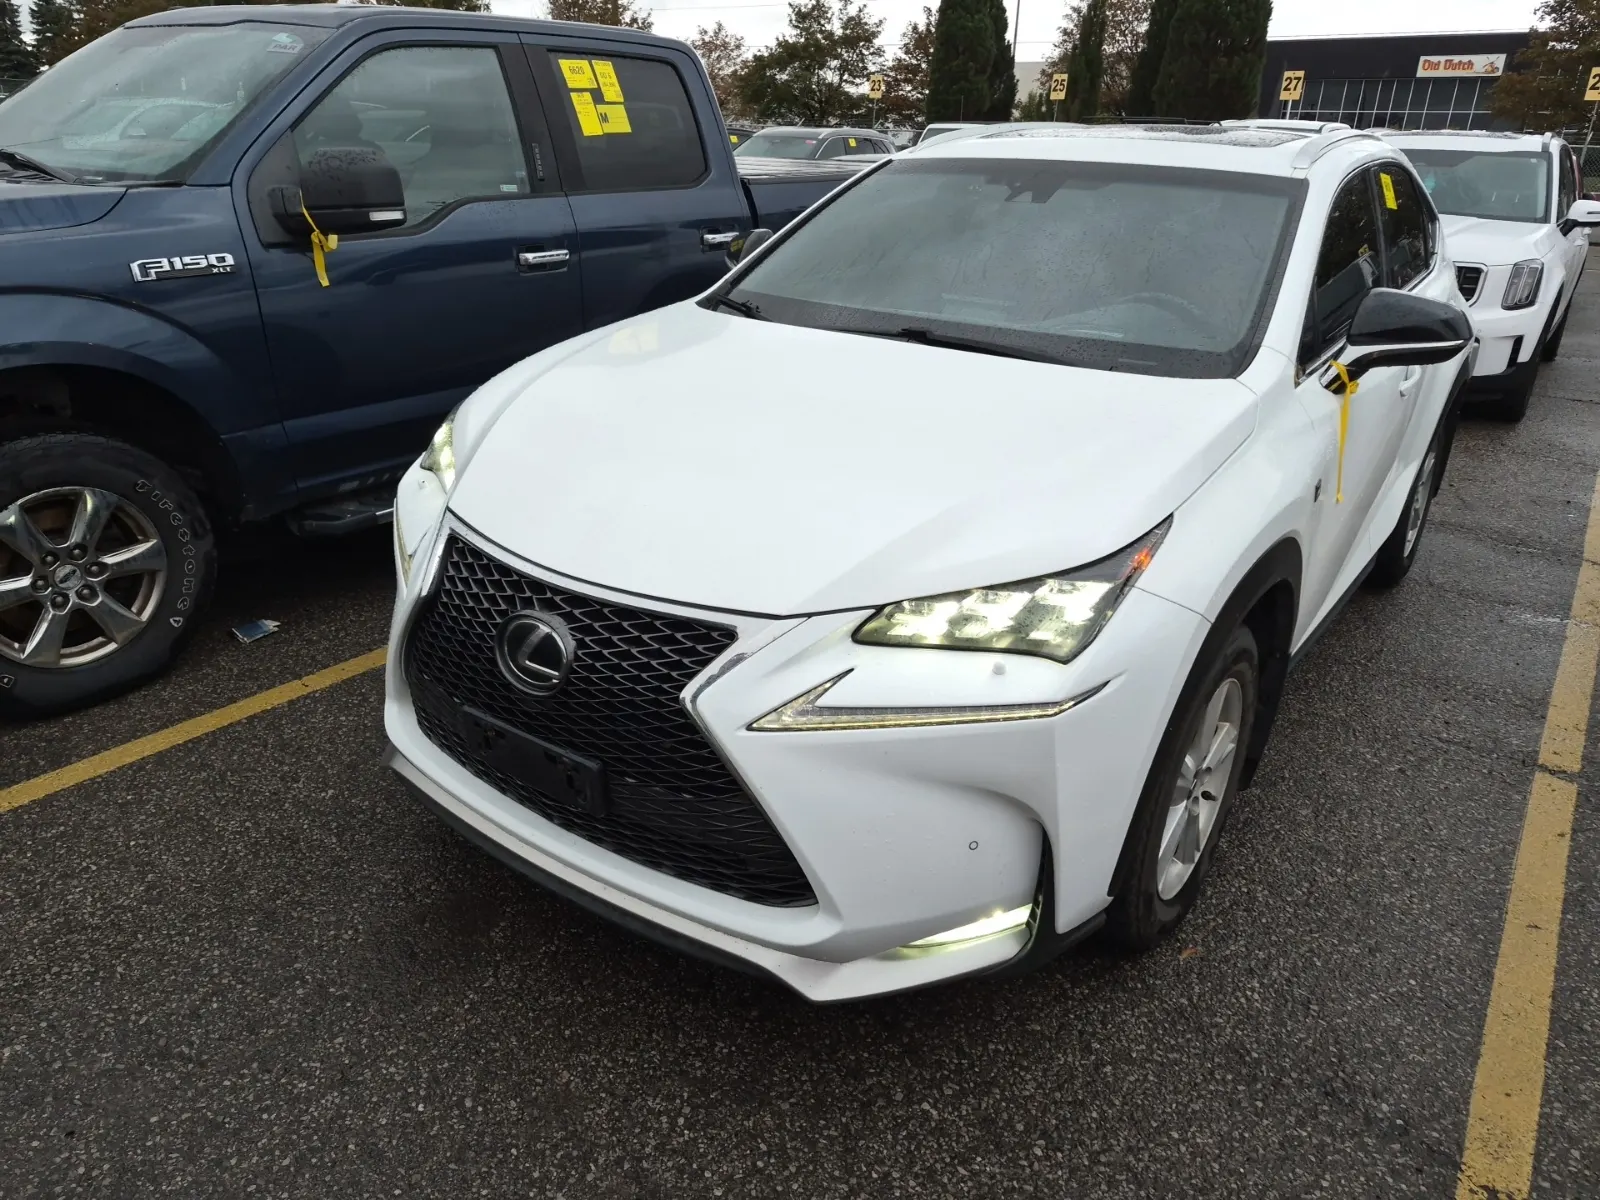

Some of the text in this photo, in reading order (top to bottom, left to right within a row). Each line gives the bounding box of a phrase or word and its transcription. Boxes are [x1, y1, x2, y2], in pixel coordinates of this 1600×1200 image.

[1422, 58, 1475, 71] Old Dutch
[870, 79, 882, 92] 23
[1052, 78, 1066, 92] 25
[1282, 76, 1302, 92] 27
[599, 112, 609, 124] M
[129, 253, 235, 282] F150
[212, 266, 232, 274] XLT
[135, 479, 195, 610] Firestone
